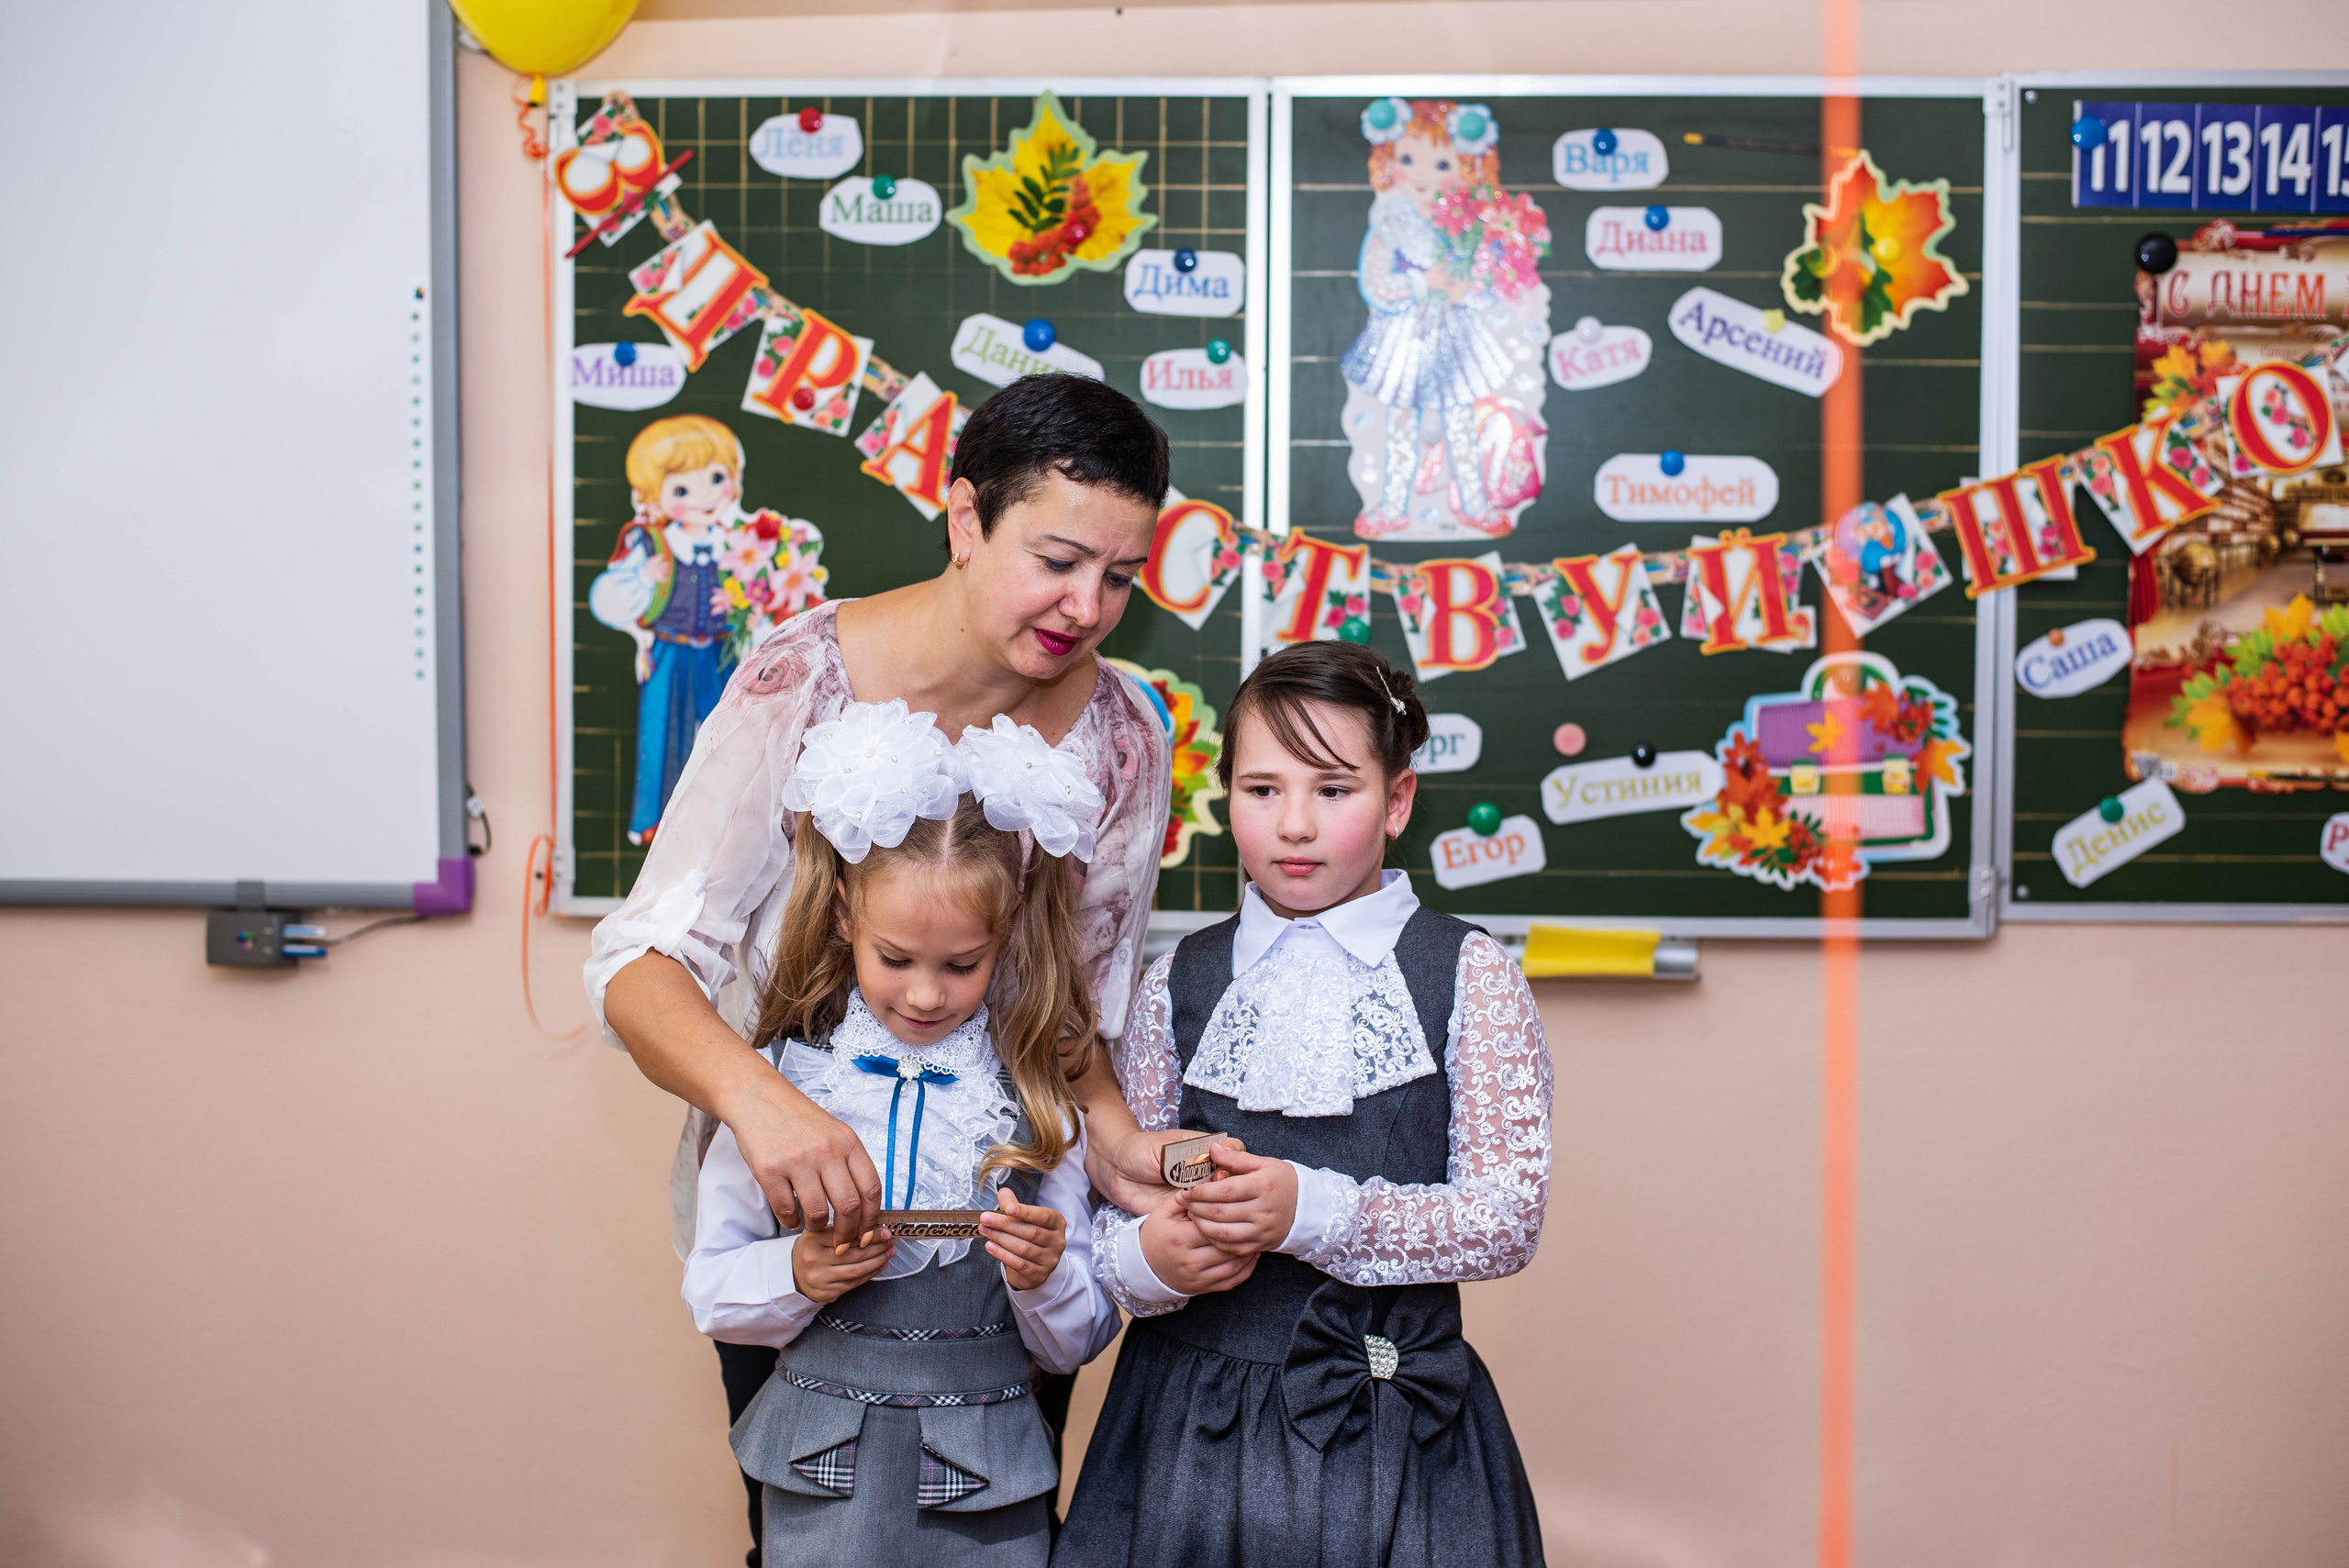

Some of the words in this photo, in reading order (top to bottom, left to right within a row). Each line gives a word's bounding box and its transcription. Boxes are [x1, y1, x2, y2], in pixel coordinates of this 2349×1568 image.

[1564, 144, 1649, 182] Варя
[2091, 120, 2131, 192] 11
[2141, 120, 2191, 194] 12
[2202, 121, 2252, 195] 13
[2260, 123, 2311, 195] 14
[830, 194, 934, 224] Маша
[1595, 221, 1708, 256] Диана
[1132, 264, 1230, 300] Дима
[2166, 270, 2189, 318] С
[2205, 271, 2328, 319] ДНЕМ
[1555, 336, 1642, 383] Катя
[1679, 300, 1828, 381] Арсений
[554, 119, 1811, 672] ЗДРАСТВУЙ,
[570, 356, 676, 388] Миша
[1146, 359, 1234, 391] Илья
[1604, 474, 1756, 512] Тимофей
[2022, 632, 2118, 690] Саша
[1551, 770, 1703, 809] Устиния
[1442, 833, 1526, 870] Егор
[2065, 803, 2167, 879] Денис
